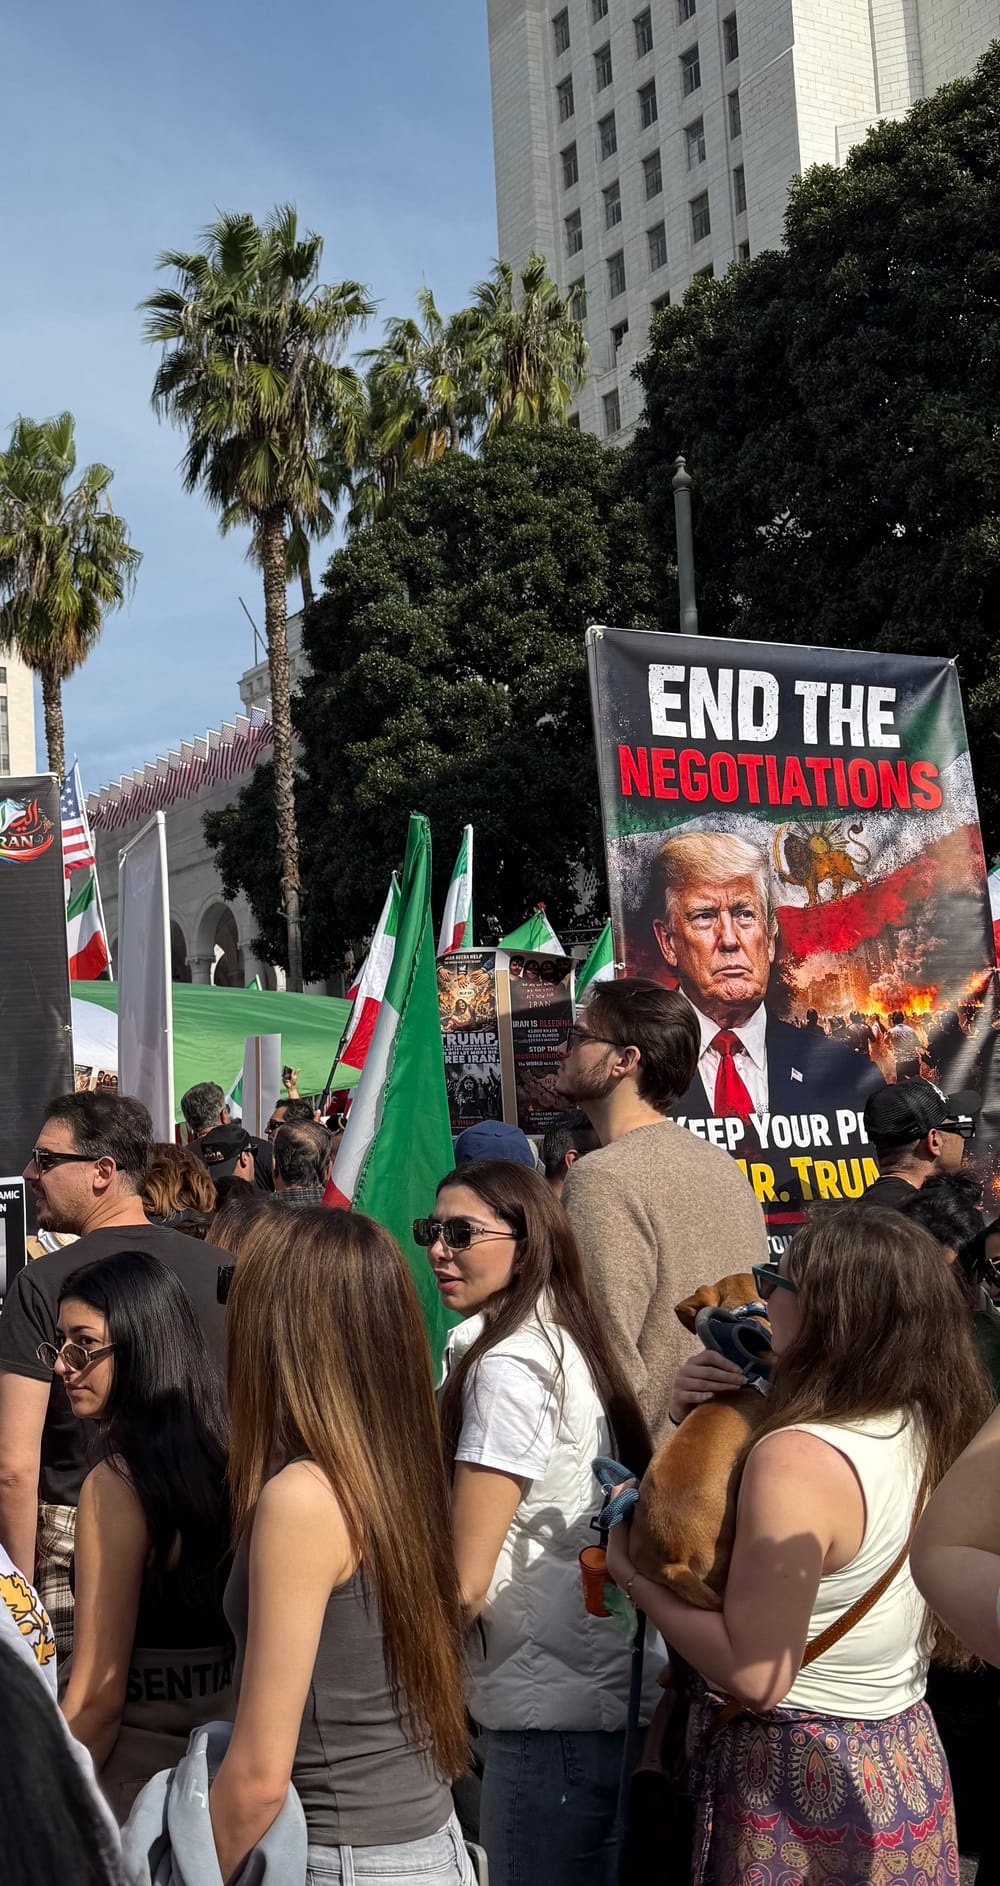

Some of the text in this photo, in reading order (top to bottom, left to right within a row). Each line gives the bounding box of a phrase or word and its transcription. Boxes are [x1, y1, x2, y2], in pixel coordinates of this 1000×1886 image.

[648, 663, 901, 748] END THE
[617, 744, 943, 811] NEGOTIATIONS
[528, 1000, 551, 1009] IRAN
[512, 1020, 530, 1028] IRAN
[530, 1020, 538, 1028] IS
[445, 1054, 500, 1064] REE IRAN.
[748, 1112, 833, 1149] YOUR
[127, 1662, 233, 1702] SENTIA
